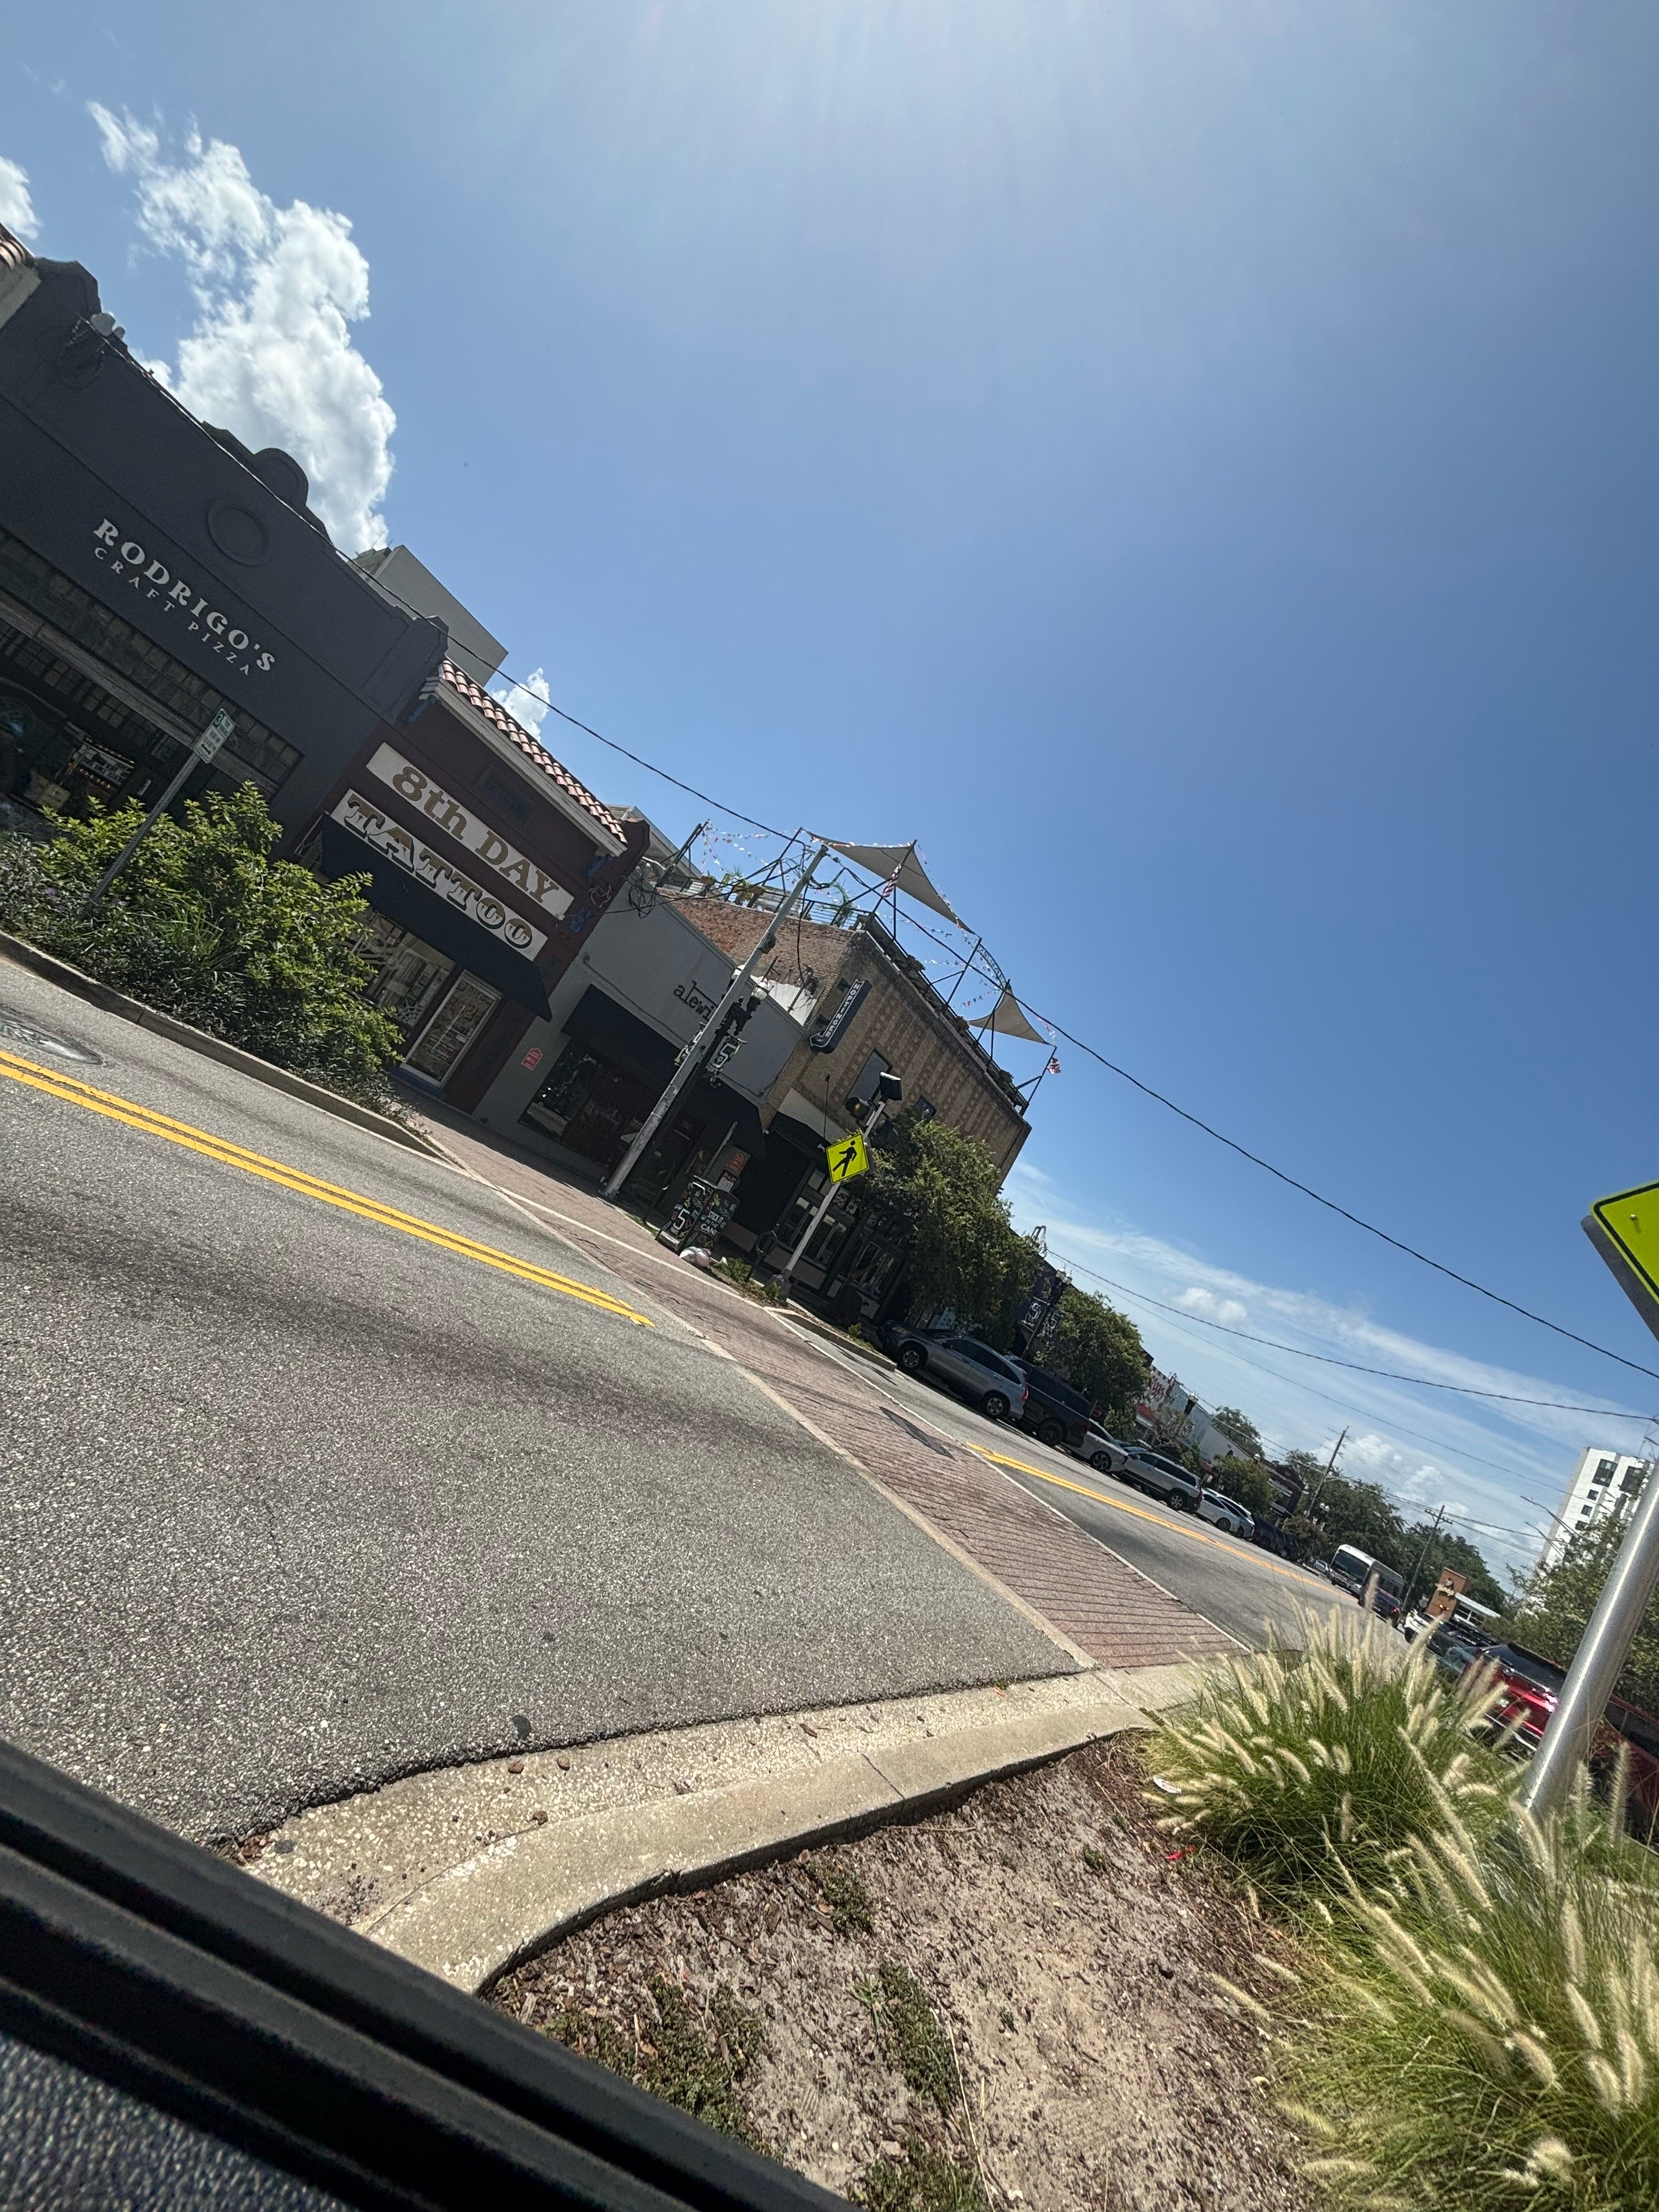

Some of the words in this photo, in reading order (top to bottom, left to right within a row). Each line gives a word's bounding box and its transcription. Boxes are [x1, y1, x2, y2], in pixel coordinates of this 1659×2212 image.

[93, 518, 275, 671] RODRIGO'S
[94, 547, 175, 612] CRAFT
[188, 621, 250, 675] PIZZA
[215, 714, 224, 724] 3
[392, 767, 469, 841] 8th
[475, 831, 560, 903] DAY
[344, 794, 532, 949] TATTOO
[674, 980, 717, 1022] alewi
[825, 983, 860, 1038] HOPTINGER
[712, 1043, 737, 1068] 5
[674, 1208, 690, 1230] 5
